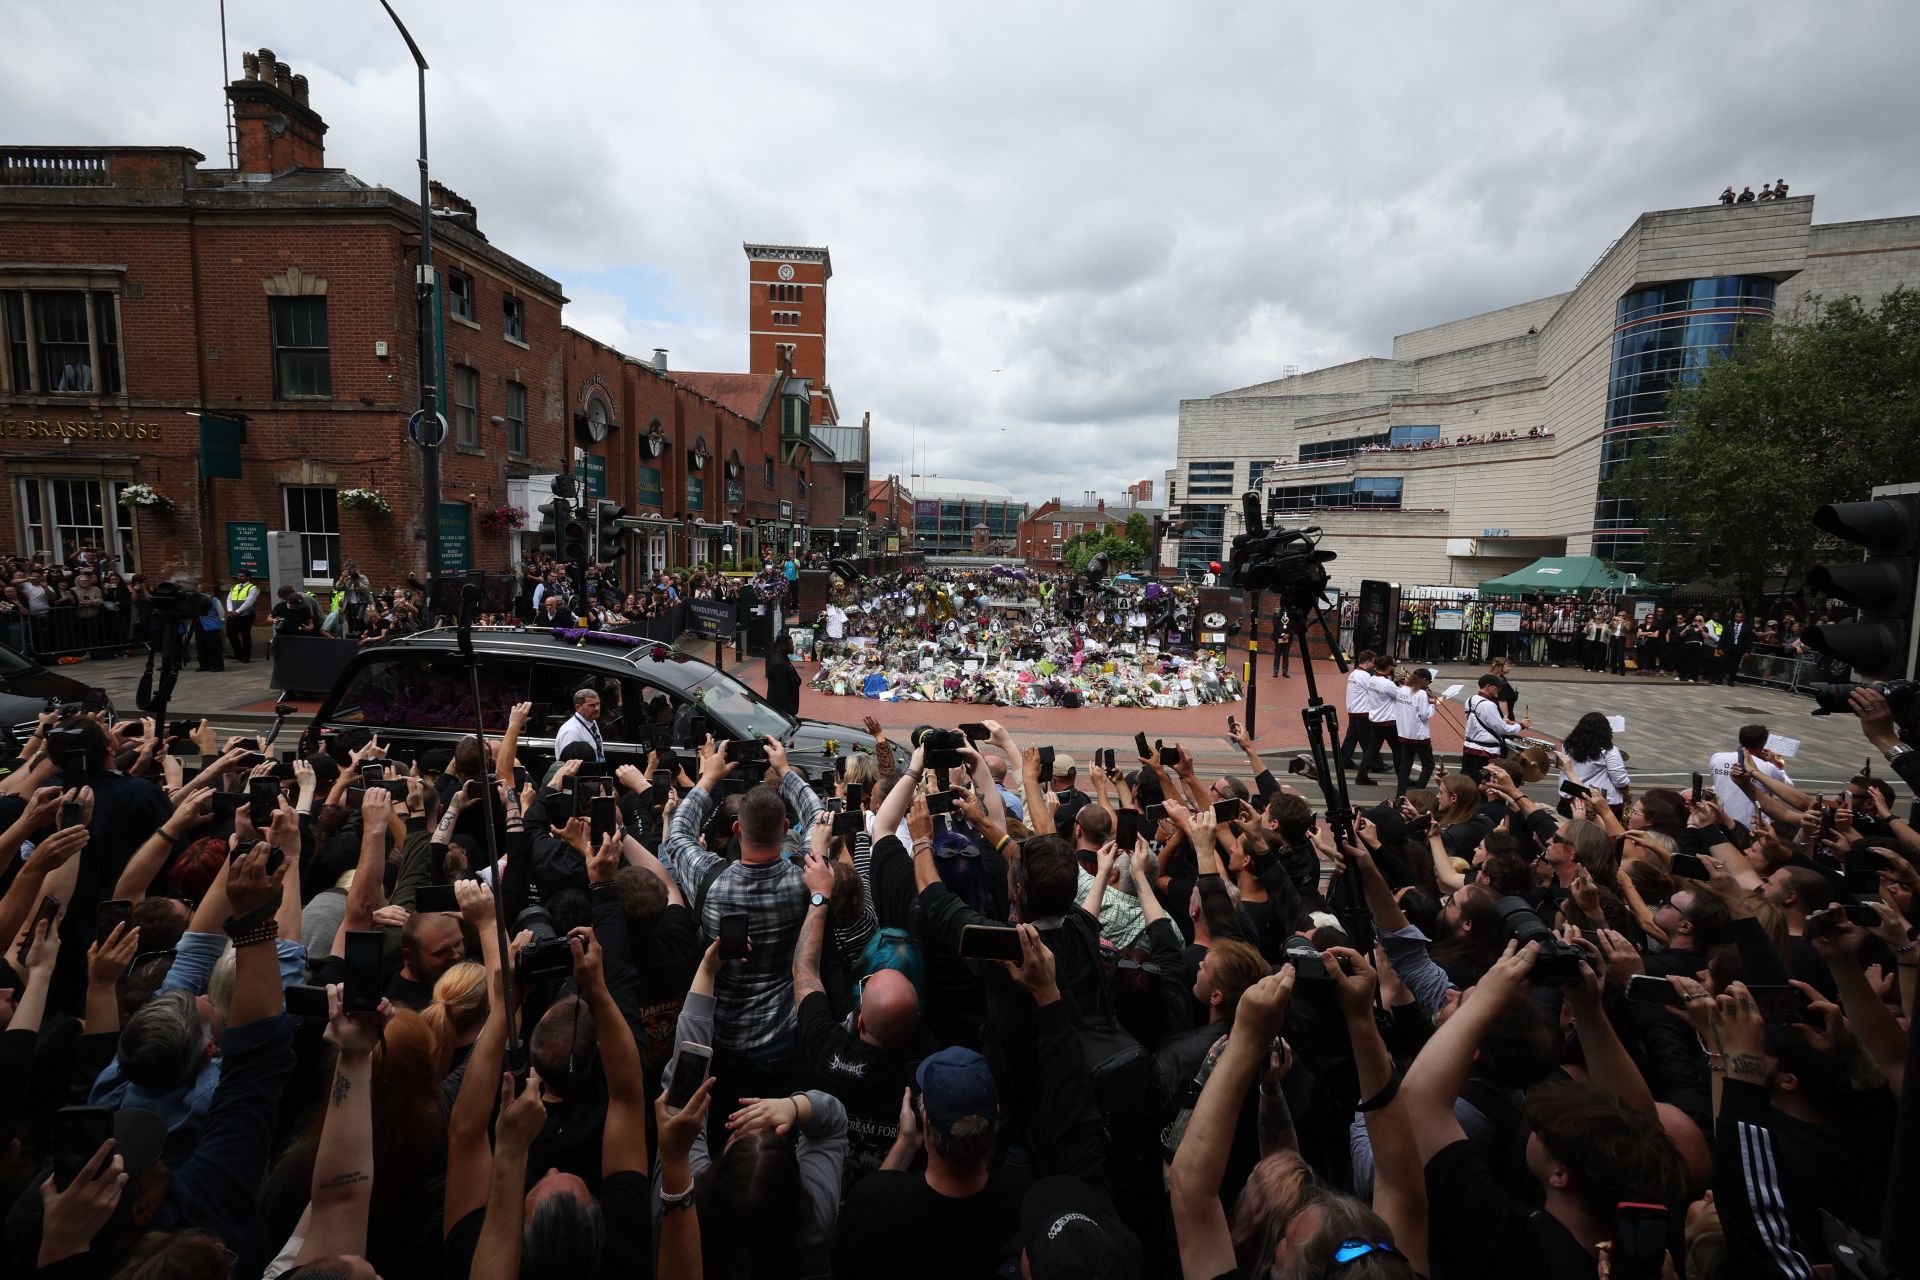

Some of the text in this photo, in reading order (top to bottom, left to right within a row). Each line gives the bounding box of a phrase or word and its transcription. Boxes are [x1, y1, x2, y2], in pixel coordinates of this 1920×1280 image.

[24, 420, 160, 439] BRASSHOUSE
[1484, 529, 1501, 537] BAY
[691, 604, 729, 618] BRINDLEYPLACE
[877, 1125, 898, 1138] FOR
